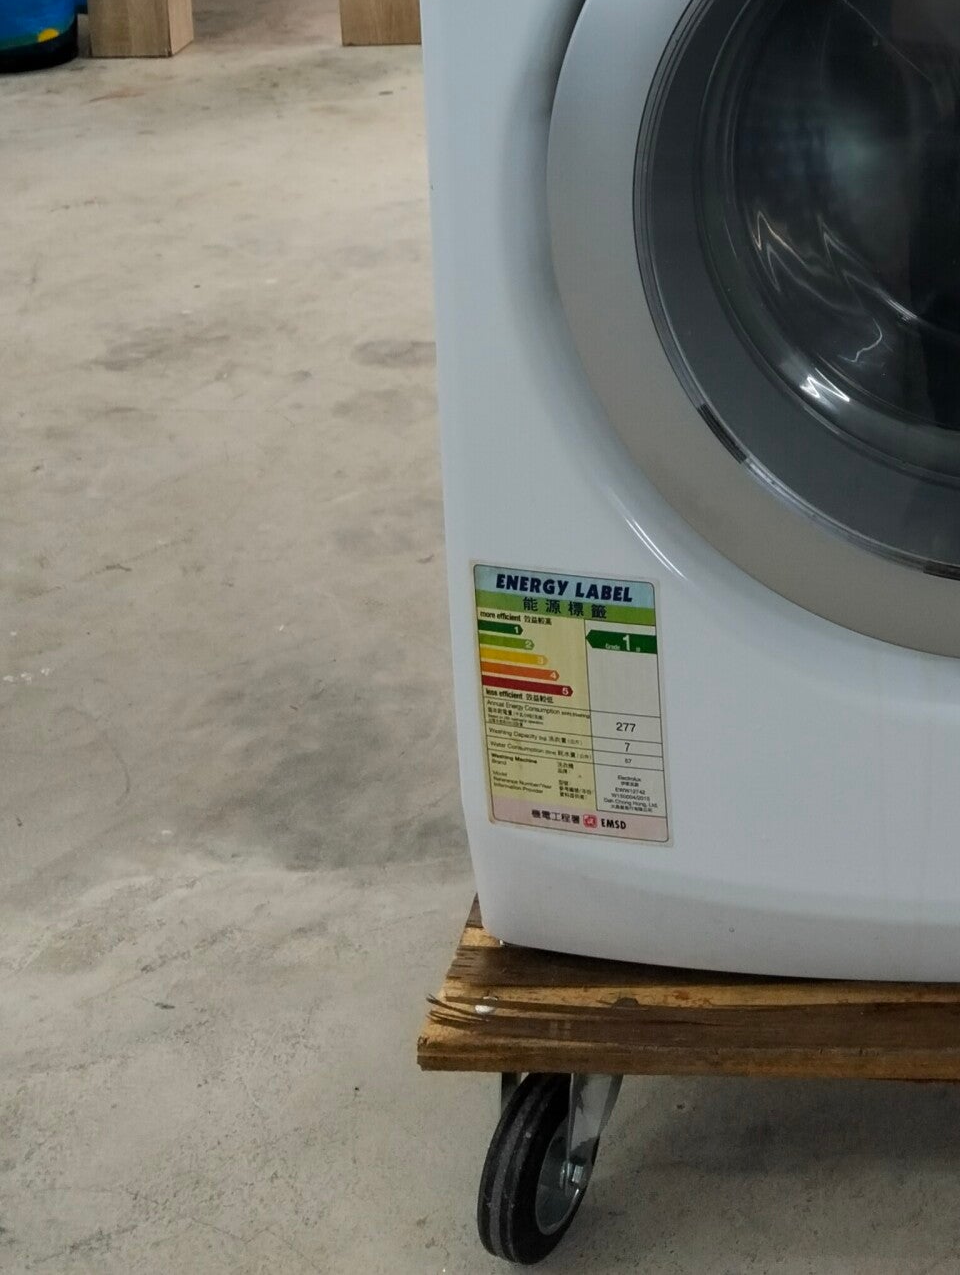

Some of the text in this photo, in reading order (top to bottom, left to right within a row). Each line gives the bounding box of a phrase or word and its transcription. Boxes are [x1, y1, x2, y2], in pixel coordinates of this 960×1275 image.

[496, 574, 633, 603] ENERGY LABEL
[480, 611, 521, 623] more efficient
[514, 626, 519, 634] 1
[525, 640, 532, 649] 2
[622, 634, 630, 651] 1
[550, 671, 557, 679] 4
[499, 690, 523, 700] efficient
[562, 687, 569, 695] 5
[616, 722, 636, 733] 277
[624, 742, 631, 752] 7
[601, 818, 627, 830] EMSD
